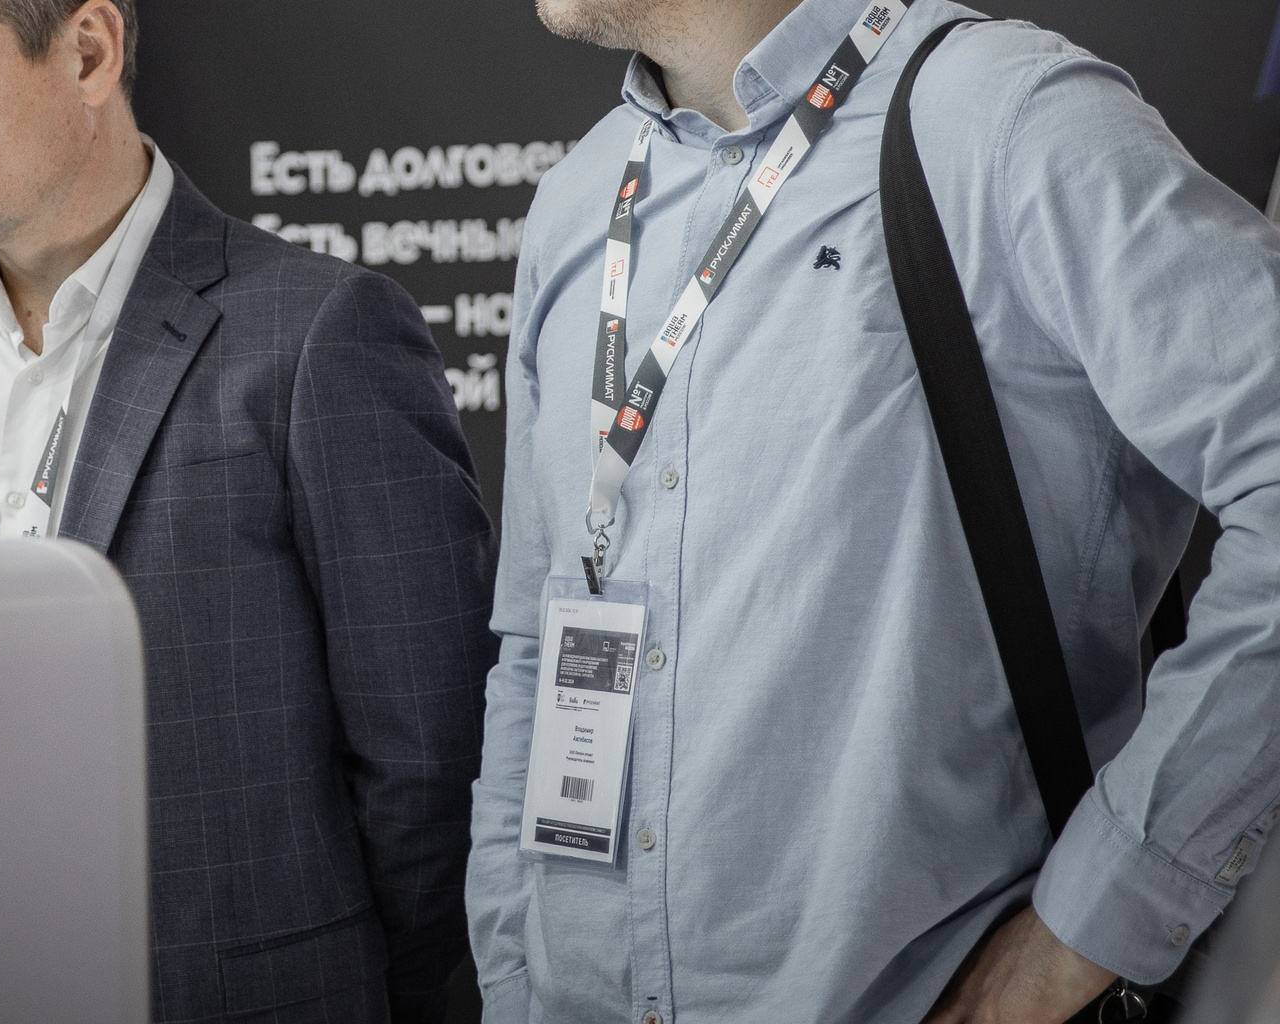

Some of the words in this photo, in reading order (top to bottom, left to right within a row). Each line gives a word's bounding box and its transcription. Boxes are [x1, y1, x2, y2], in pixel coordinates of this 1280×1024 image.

[865, 5, 881, 24] aqua
[872, 7, 891, 29] THERM
[250, 140, 357, 196] Есть
[710, 204, 753, 270] РУСКЛИМАТ
[663, 315, 679, 337] aqua
[669, 313, 688, 339] THERM
[605, 334, 616, 401] РУСКЛИМАТ
[43, 416, 64, 480] РУСКЛИМАТ
[555, 834, 589, 847] ПОСЕТИТЕЛЬ
